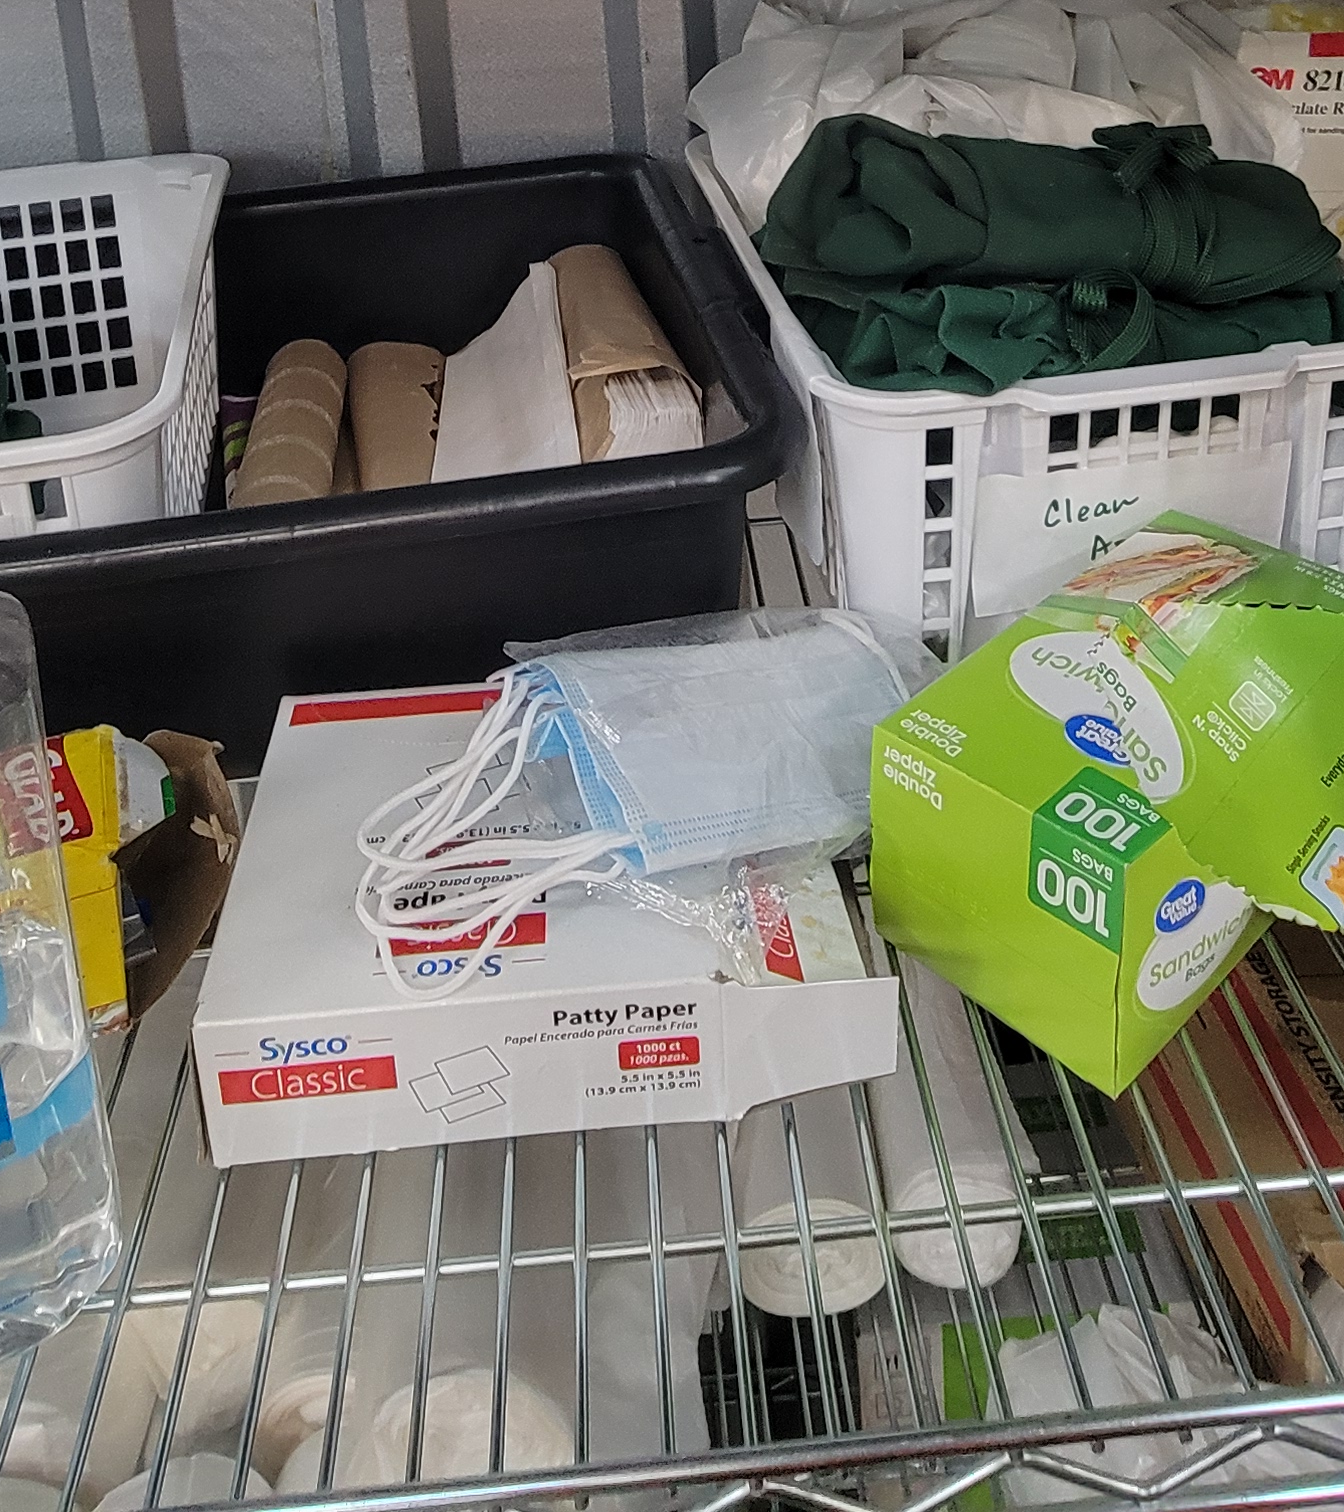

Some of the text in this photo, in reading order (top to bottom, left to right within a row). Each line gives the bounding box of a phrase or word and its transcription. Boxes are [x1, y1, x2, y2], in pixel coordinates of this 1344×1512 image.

[1044, 495, 1139, 529] Clean
[884, 746, 936, 788] Zipper
[883, 764, 942, 810] Double
[1055, 792, 1142, 852] 100
[1037, 859, 1110, 938] 100
[553, 1003, 697, 1027] Patty Paper
[259, 1038, 348, 1064] Sysco
[251, 1065, 367, 1101] Classic
